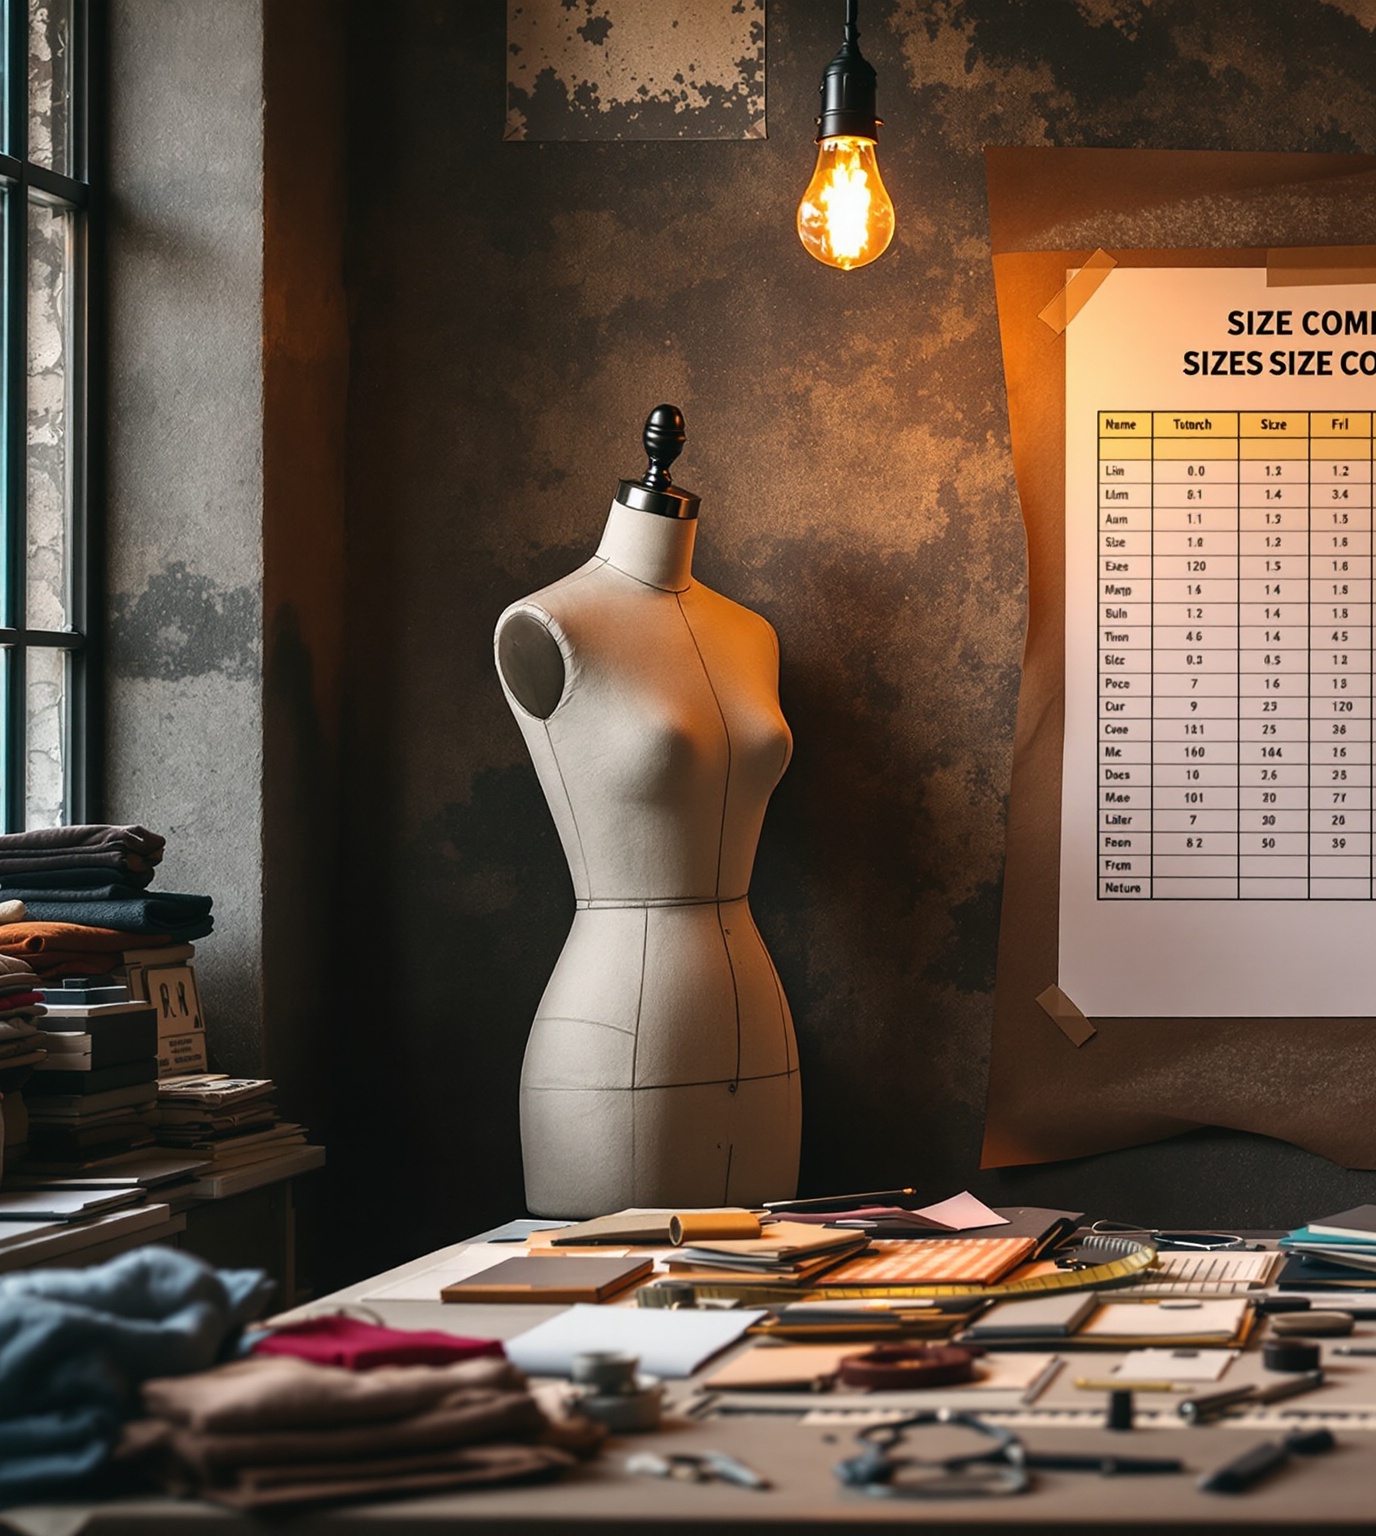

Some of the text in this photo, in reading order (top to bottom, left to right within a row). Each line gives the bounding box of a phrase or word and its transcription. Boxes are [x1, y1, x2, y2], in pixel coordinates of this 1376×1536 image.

[1227, 310, 1293, 336] SIZE
[1182, 350, 1264, 376] SIZES
[1269, 350, 1333, 376] SIZE
[1332, 465, 1350, 477] 1.2
[1186, 560, 1207, 572] 120
[1190, 678, 1199, 689] 7
[1190, 700, 1198, 712] 9
[1189, 814, 1198, 826] 7
